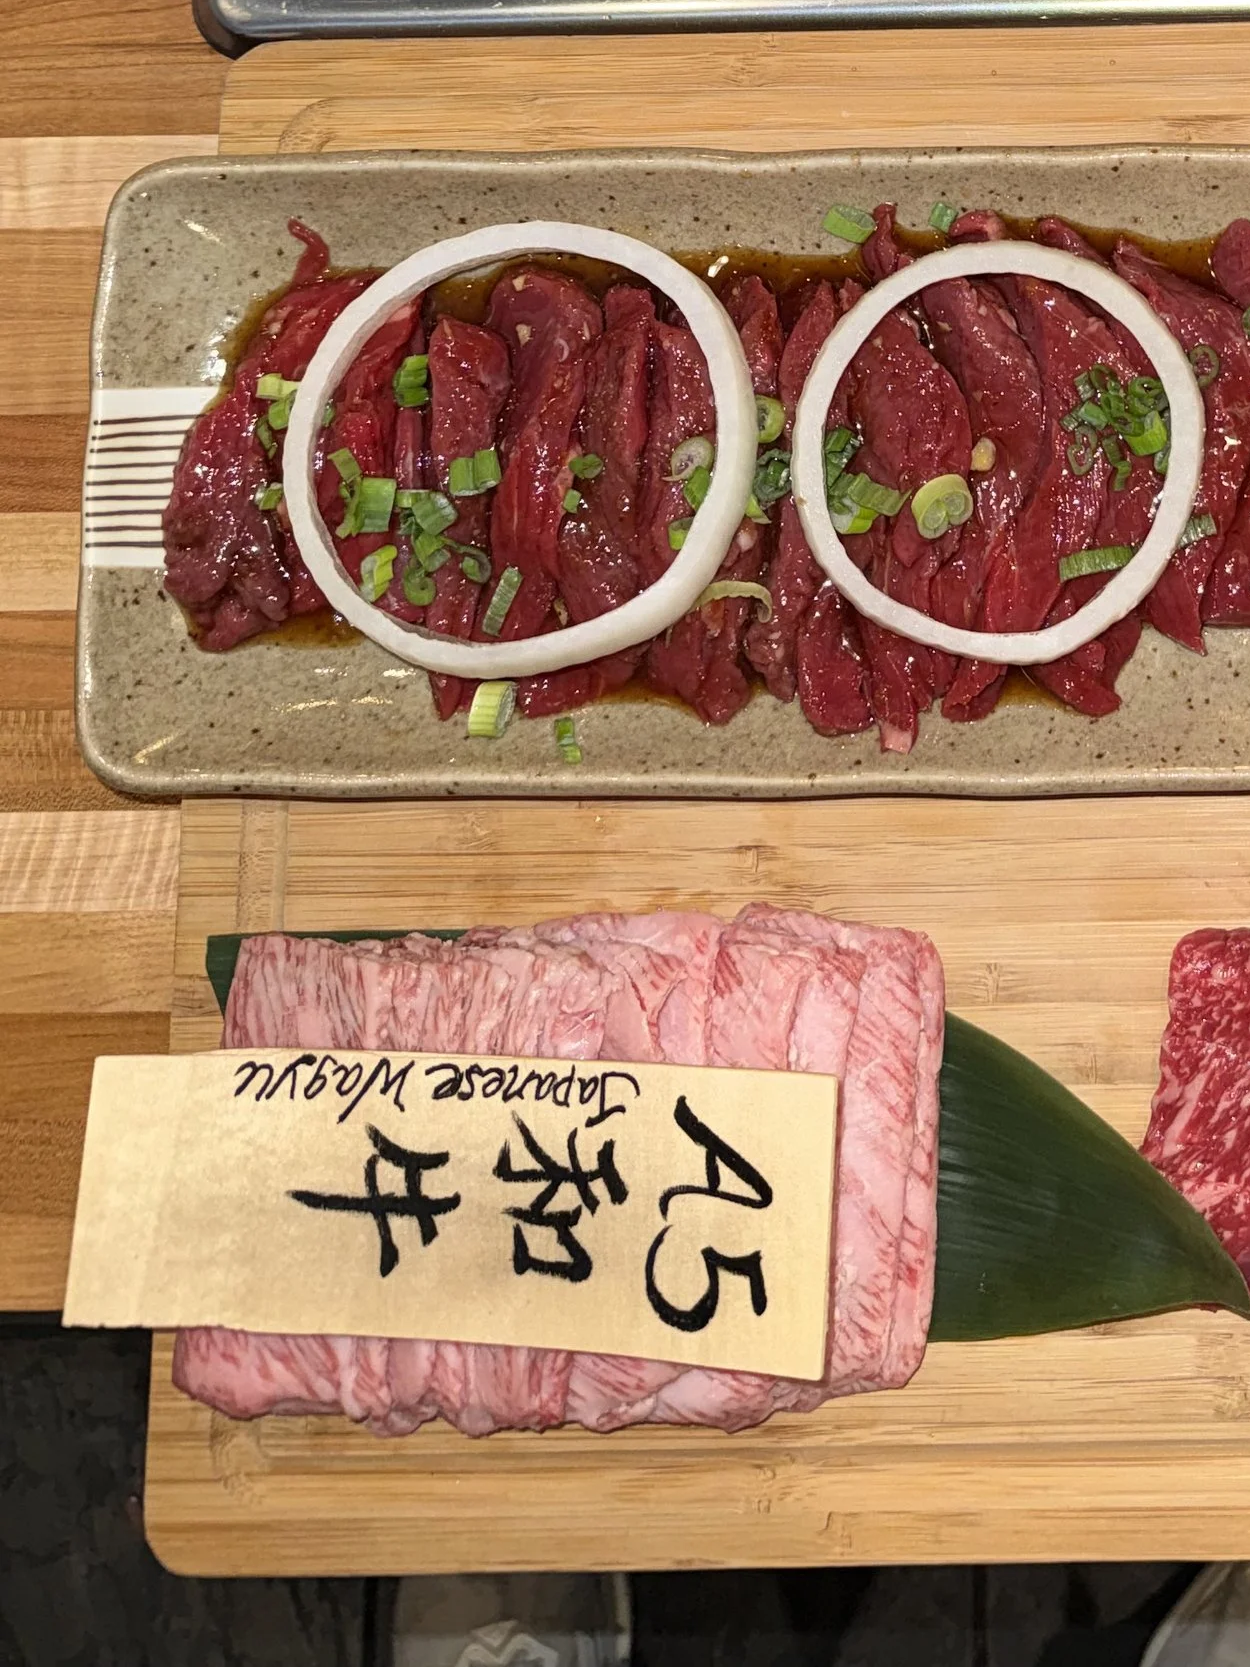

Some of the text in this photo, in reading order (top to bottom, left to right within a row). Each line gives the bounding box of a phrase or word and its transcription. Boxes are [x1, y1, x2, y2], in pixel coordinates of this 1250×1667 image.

[234, 1053, 641, 1129] Japanese Wagyu
[645, 1095, 773, 1334] A5
